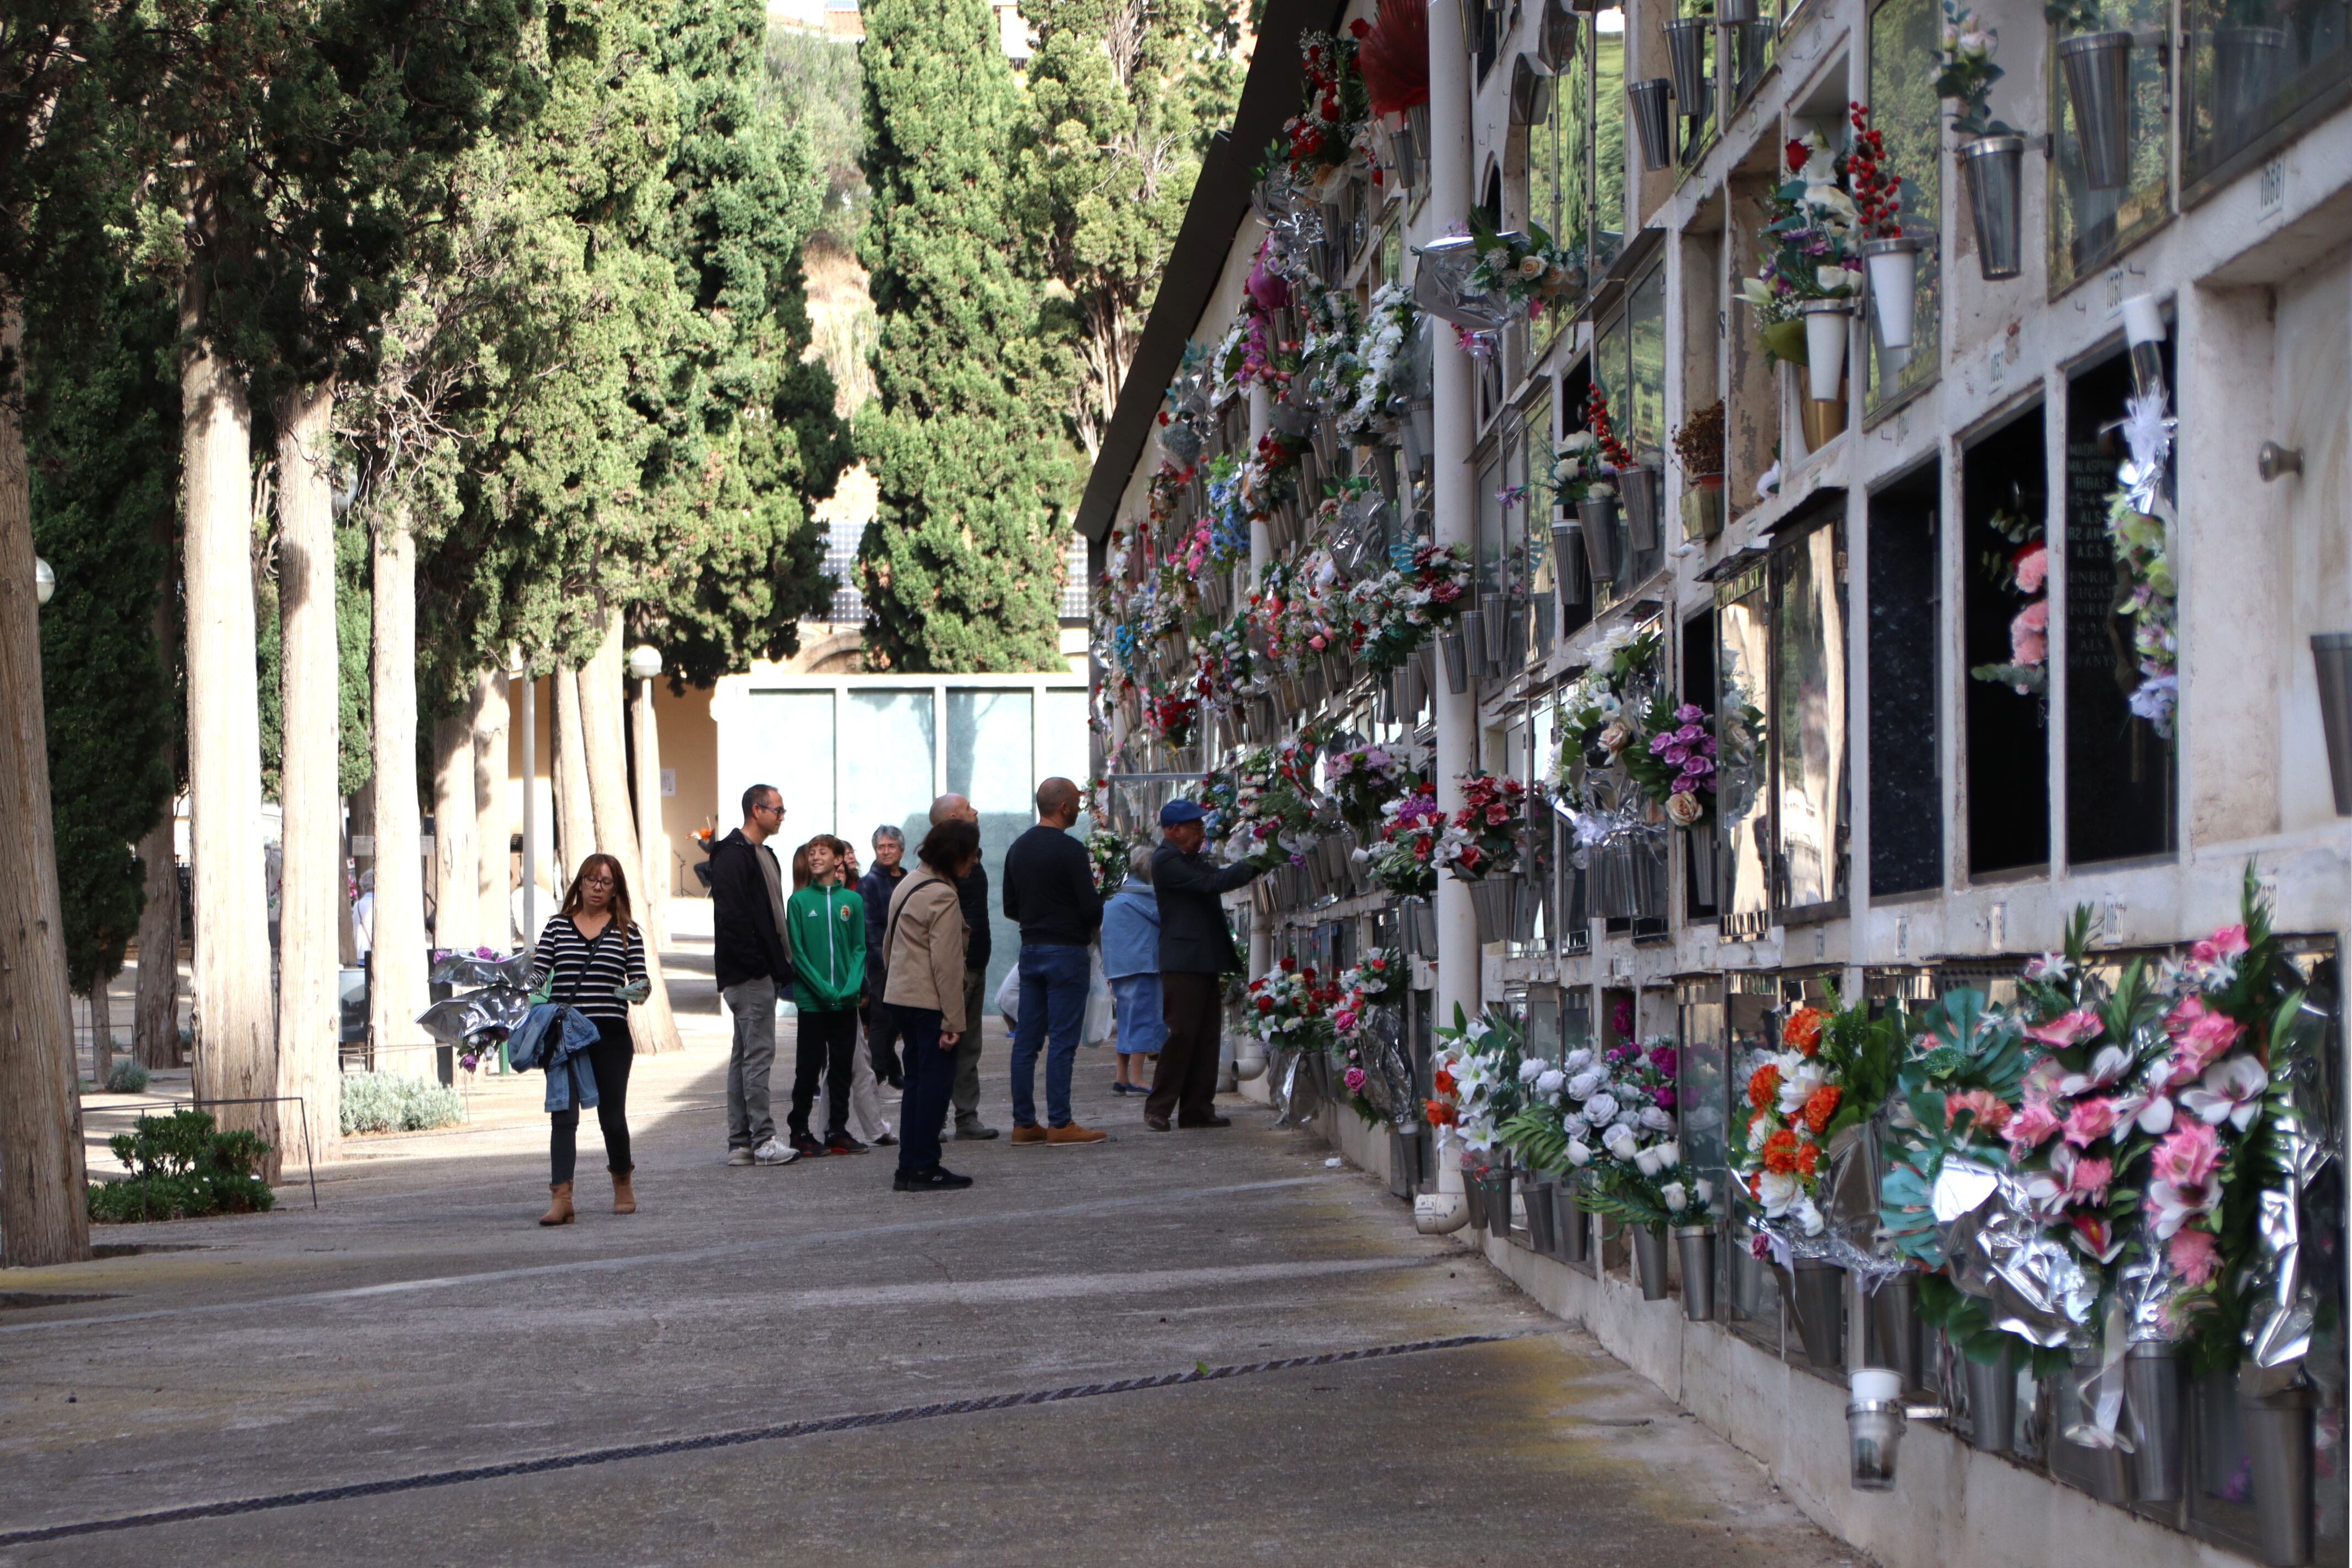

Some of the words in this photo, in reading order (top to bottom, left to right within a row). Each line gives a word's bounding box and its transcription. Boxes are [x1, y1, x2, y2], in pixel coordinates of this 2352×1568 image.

[2106, 270, 2124, 311] 1060
[1990, 350, 2004, 385] 1052
[2075, 476, 2108, 491] RIBAS
[2081, 510, 2102, 525] ALS
[2068, 526, 2082, 541] 82
[2070, 570, 2114, 584] ENRIC
